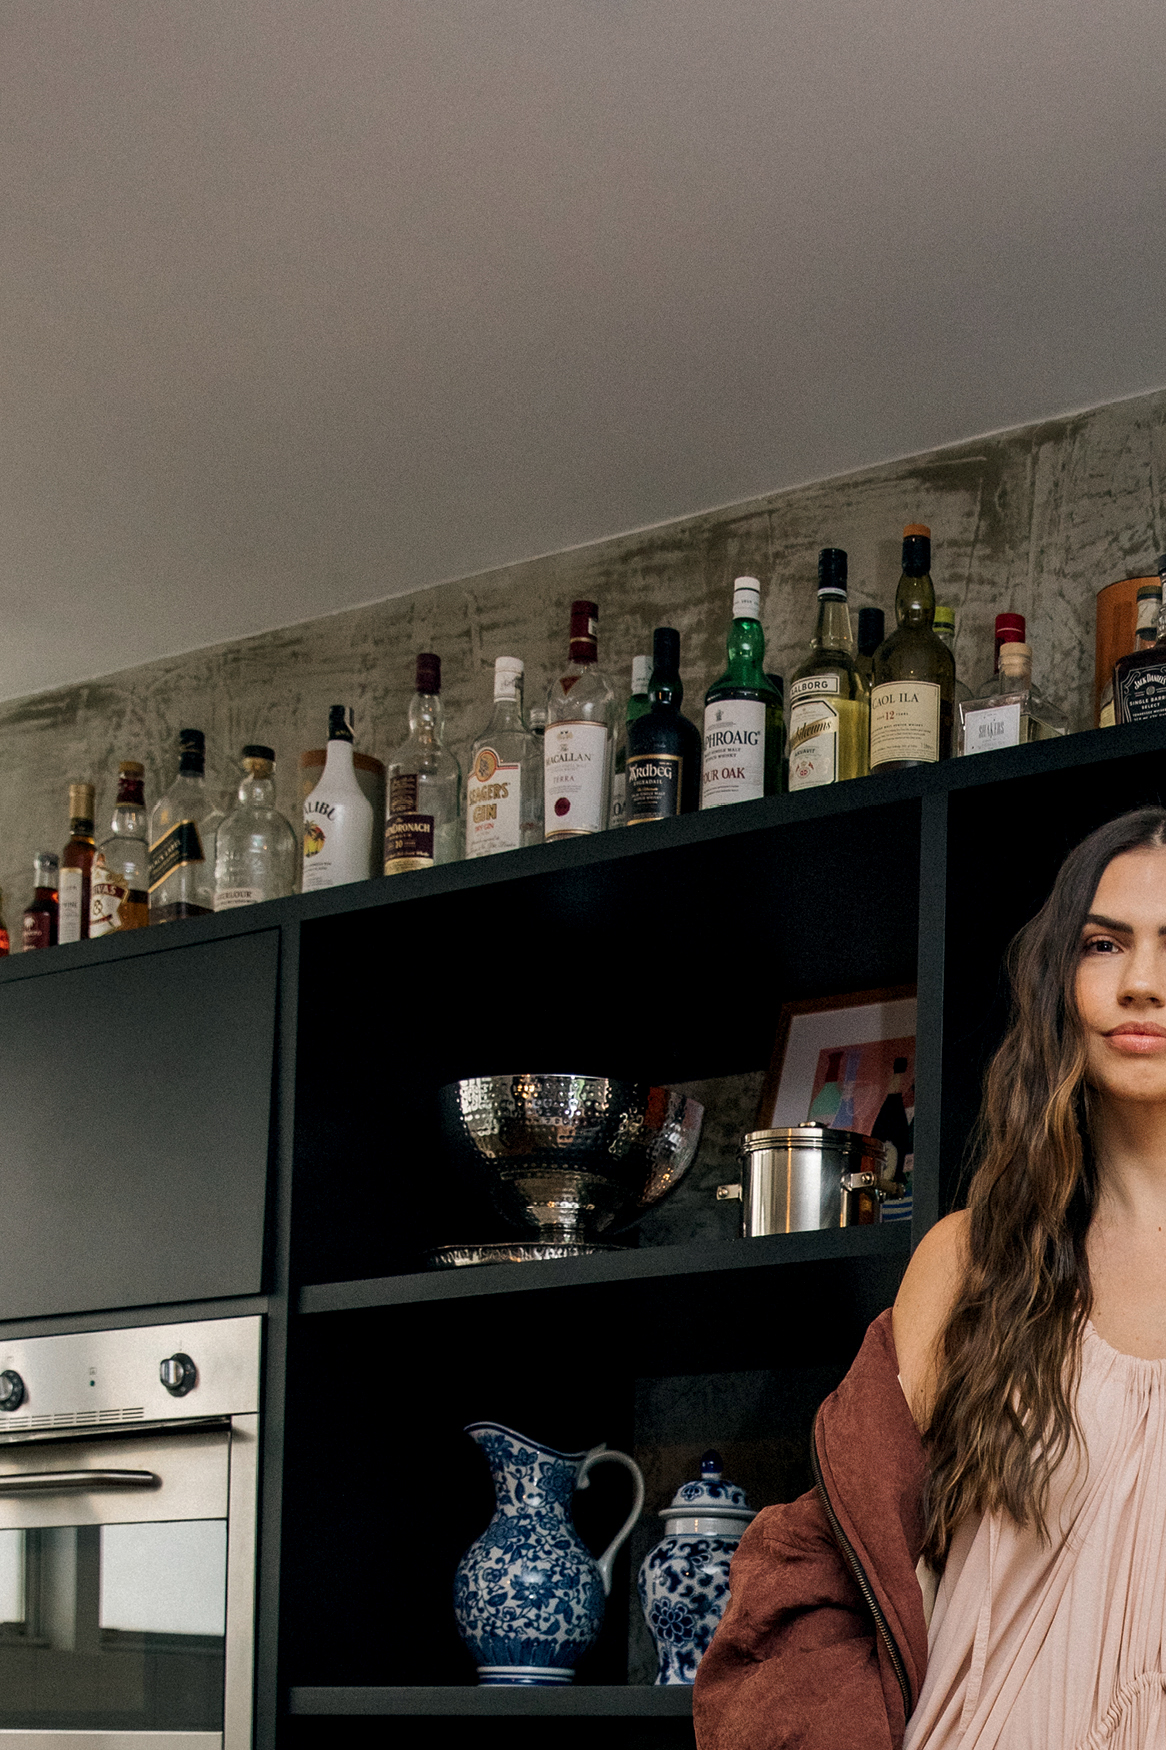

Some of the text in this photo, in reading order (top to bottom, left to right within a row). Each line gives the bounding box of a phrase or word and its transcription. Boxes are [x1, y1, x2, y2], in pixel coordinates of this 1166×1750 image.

[872, 692, 919, 710] CAOL ILA
[1129, 699, 1149, 707] SINGLE
[1141, 702, 1161, 710] SELECT
[885, 710, 895, 721] 12
[546, 753, 592, 767] MACALLAN
[553, 775, 575, 784] TERRA
[721, 767, 746, 780] OAK
[468, 782, 509, 806] SEAGERS
[473, 803, 497, 824] GIN
